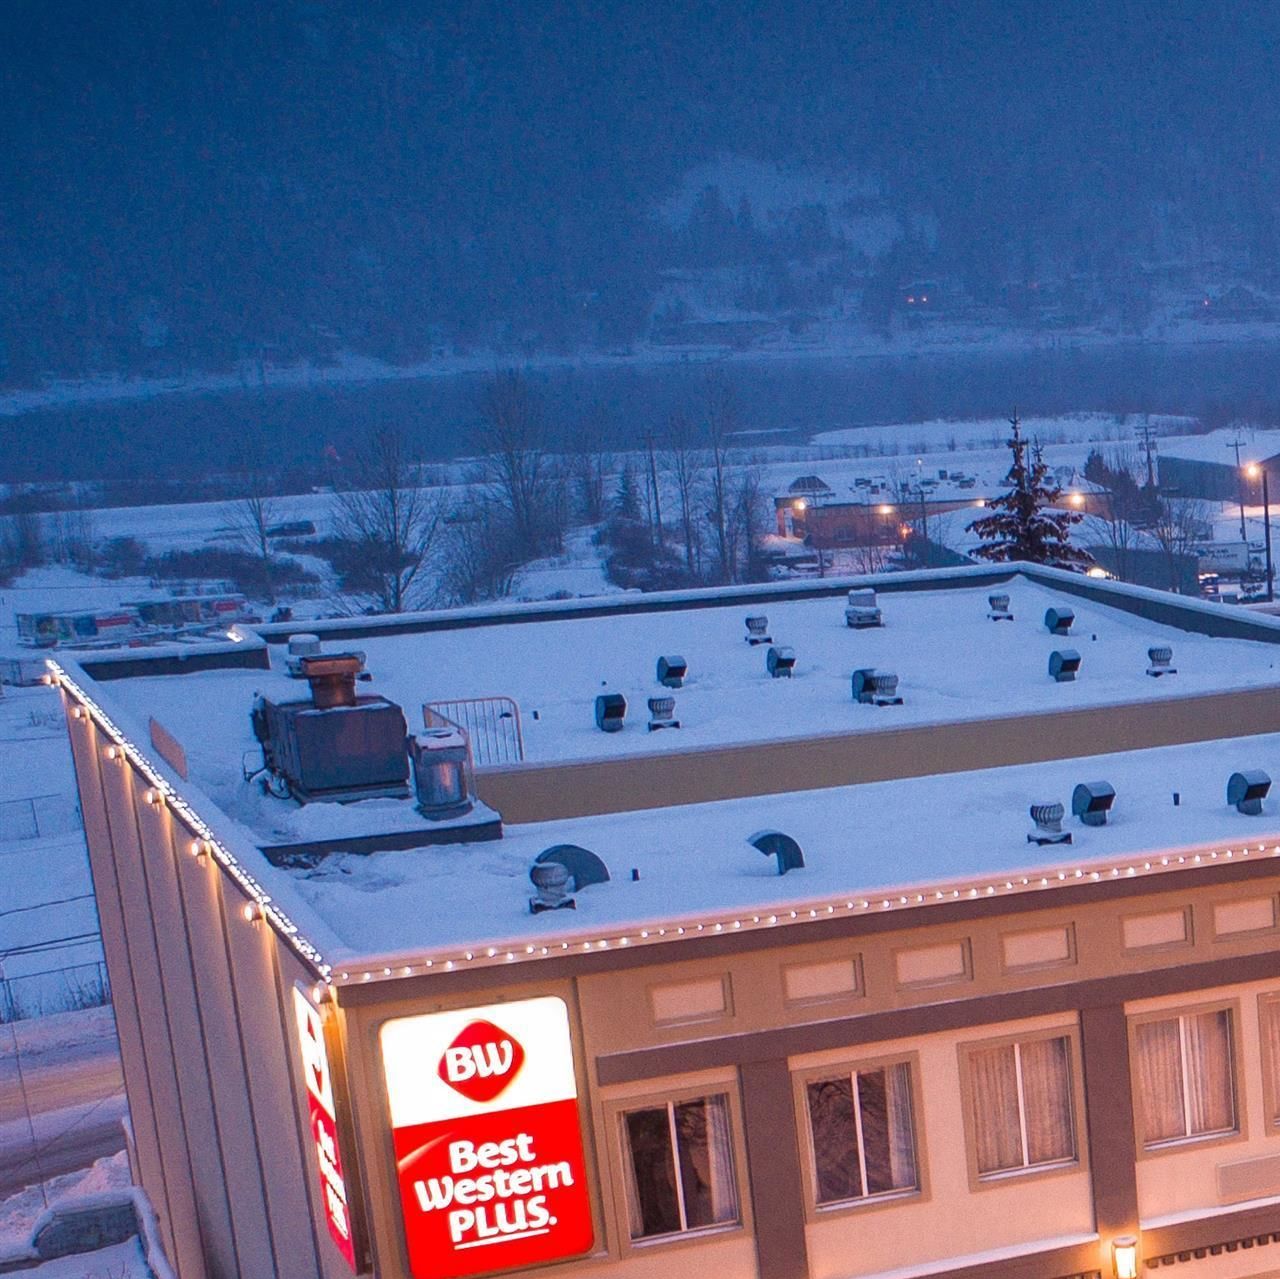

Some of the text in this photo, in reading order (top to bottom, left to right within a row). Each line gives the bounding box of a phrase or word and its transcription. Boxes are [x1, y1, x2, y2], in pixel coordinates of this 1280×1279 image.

[446, 1039, 515, 1083] BW
[448, 1132, 536, 1175] Best
[413, 1159, 575, 1213] Western
